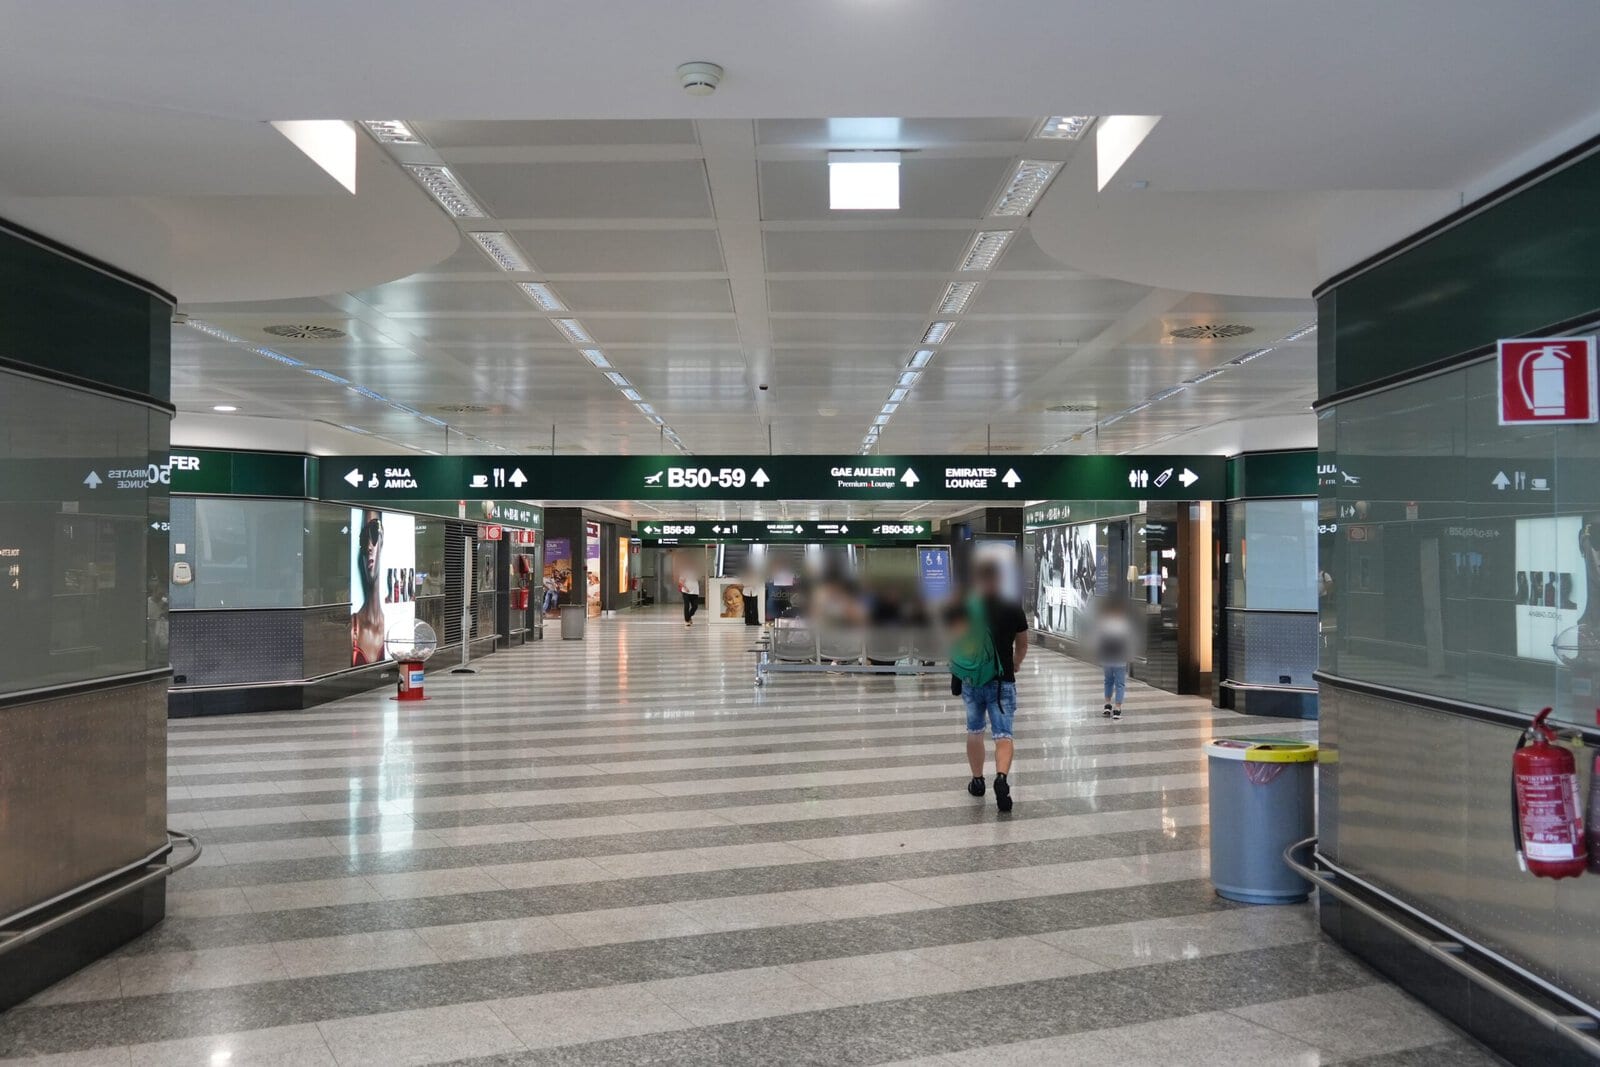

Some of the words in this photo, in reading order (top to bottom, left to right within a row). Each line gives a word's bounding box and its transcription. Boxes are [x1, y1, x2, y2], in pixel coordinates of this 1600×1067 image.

[169, 456, 200, 470] FER
[384, 468, 411, 478] SALA
[830, 467, 853, 477] GAE
[853, 467, 896, 477] AULENTI
[945, 467, 997, 478] EMIRATES
[667, 467, 746, 488] B50-59
[384, 479, 418, 489] AMICA
[837, 480, 868, 488] Premium
[871, 480, 896, 489] Lounge
[945, 478, 988, 489] LOUNGE
[662, 525, 696, 535] B56-59
[881, 524, 915, 534] B50-55
